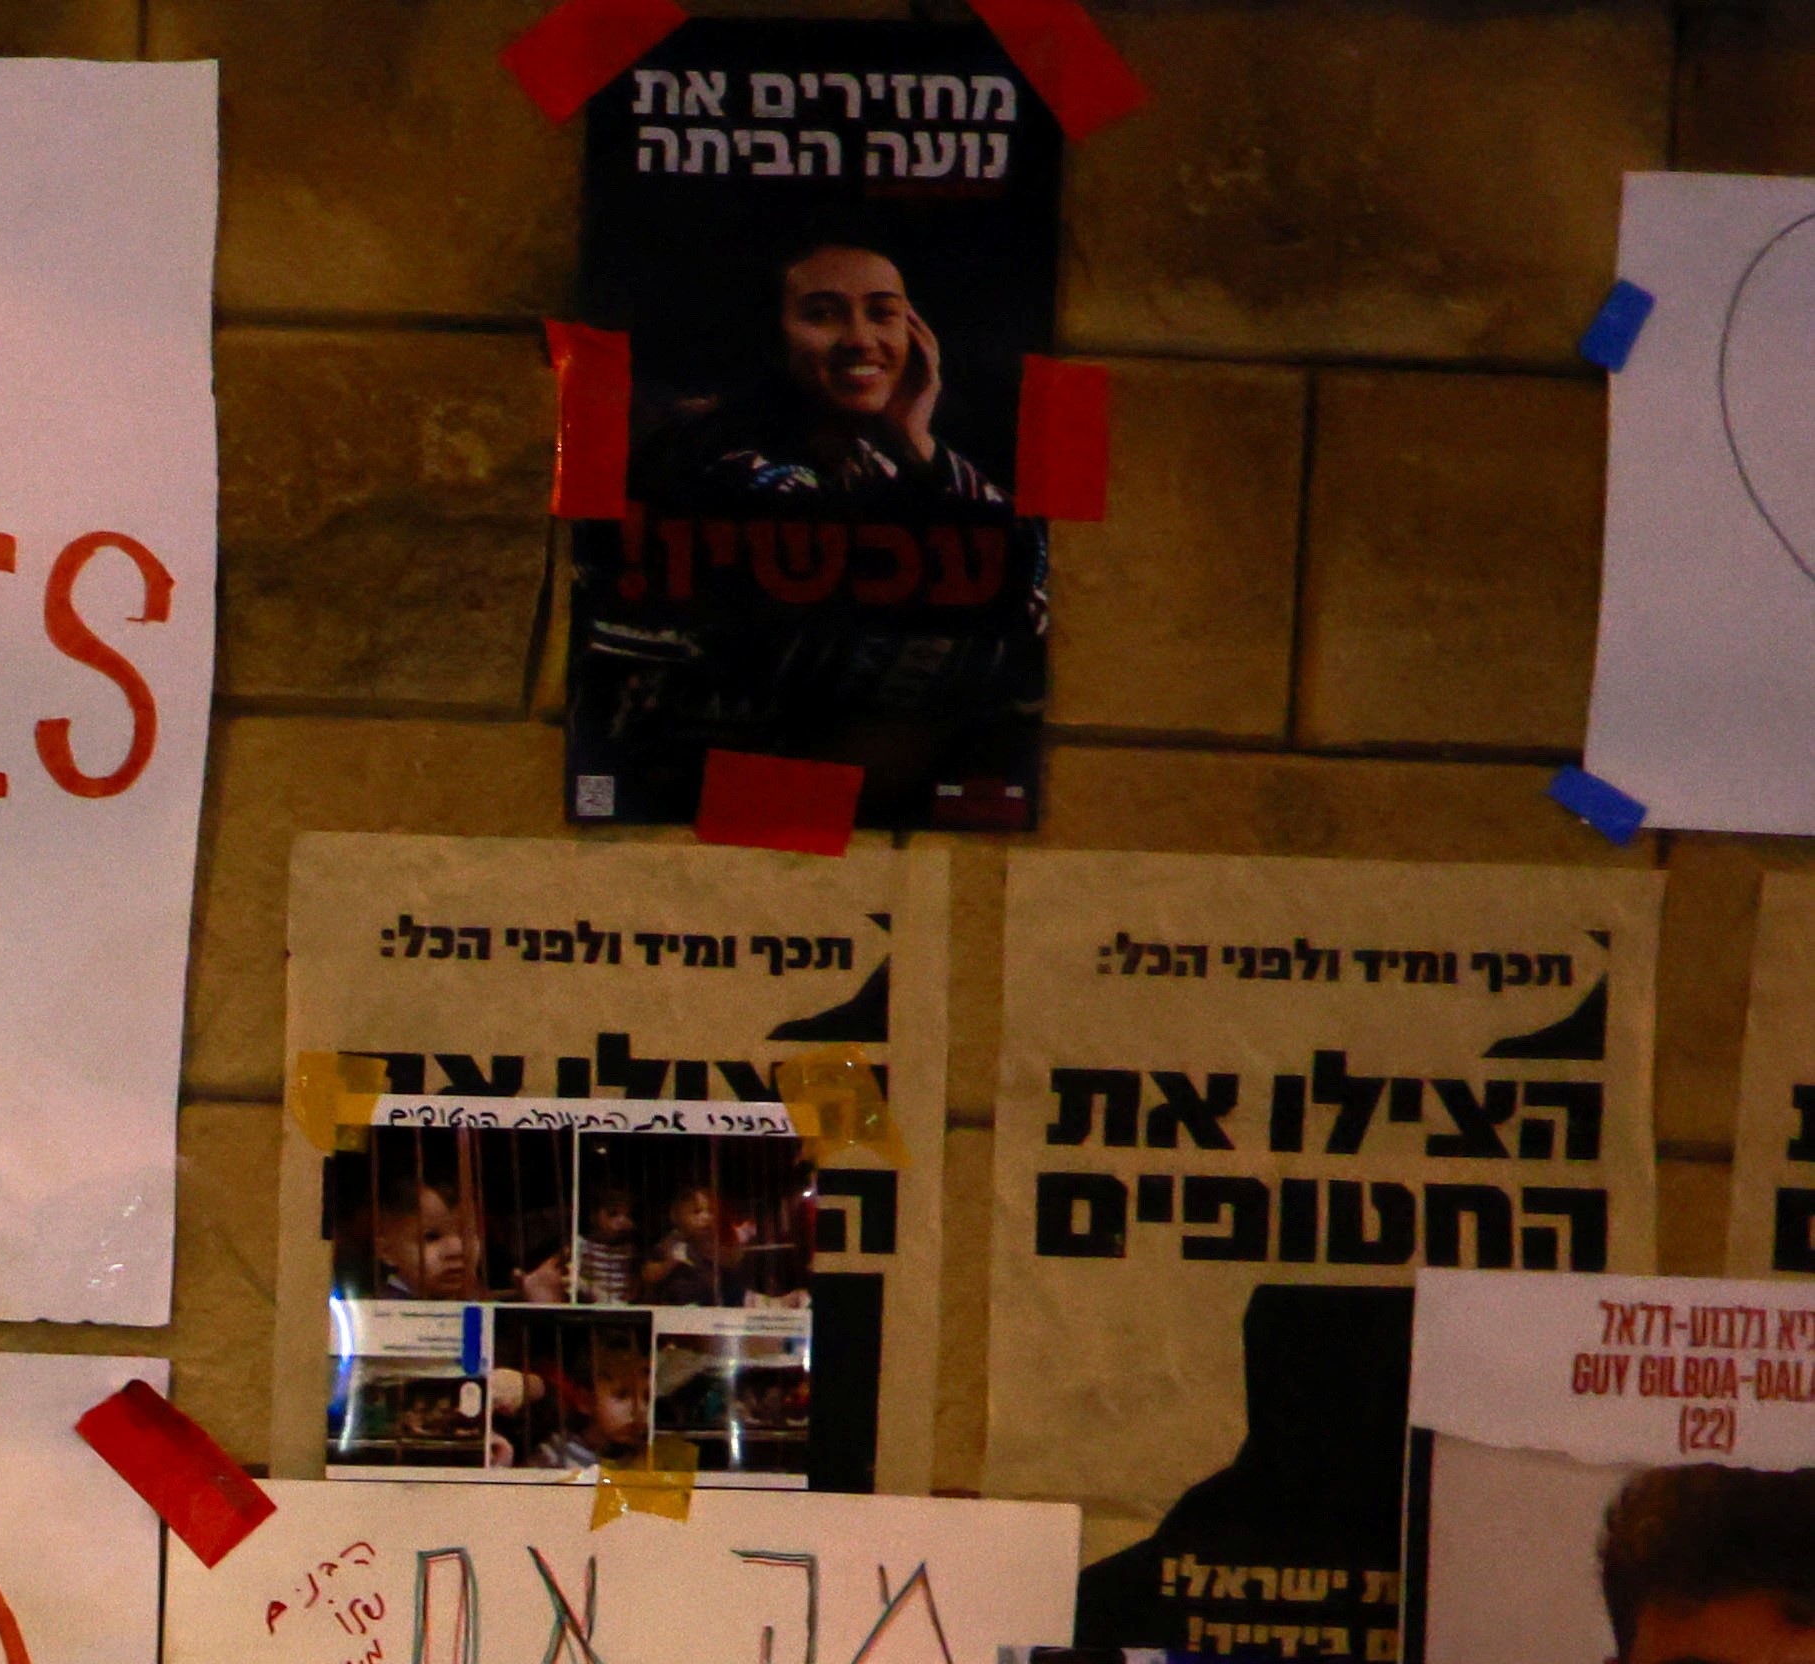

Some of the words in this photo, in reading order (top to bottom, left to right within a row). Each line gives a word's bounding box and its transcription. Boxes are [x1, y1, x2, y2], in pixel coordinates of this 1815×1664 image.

[632, 69, 727, 117] את
[750, 72, 1018, 121] מחזירים
[637, 125, 842, 176] הביתה
[865, 131, 1009, 179] נועה
[619, 501, 1010, 607] עכשיו!
[379, 914, 492, 960] הכל:
[505, 920, 621, 965] ולפני
[634, 931, 737, 968] ומיד
[750, 935, 853, 977] תכף
[1097, 932, 1209, 978] הכל:
[1220, 937, 1340, 982] ולפני
[1353, 949, 1459, 985] ומיד
[1470, 951, 1573, 993] תכף
[1046, 1067, 1240, 1150] את
[1269, 1050, 1604, 1160] הצילו
[1035, 1171, 1608, 1273] החטופים
[1572, 1352, 1631, 1396] GUY
[1678, 1404, 1738, 1454] (22)
[1160, 1552, 1349, 1602] ישראל!
